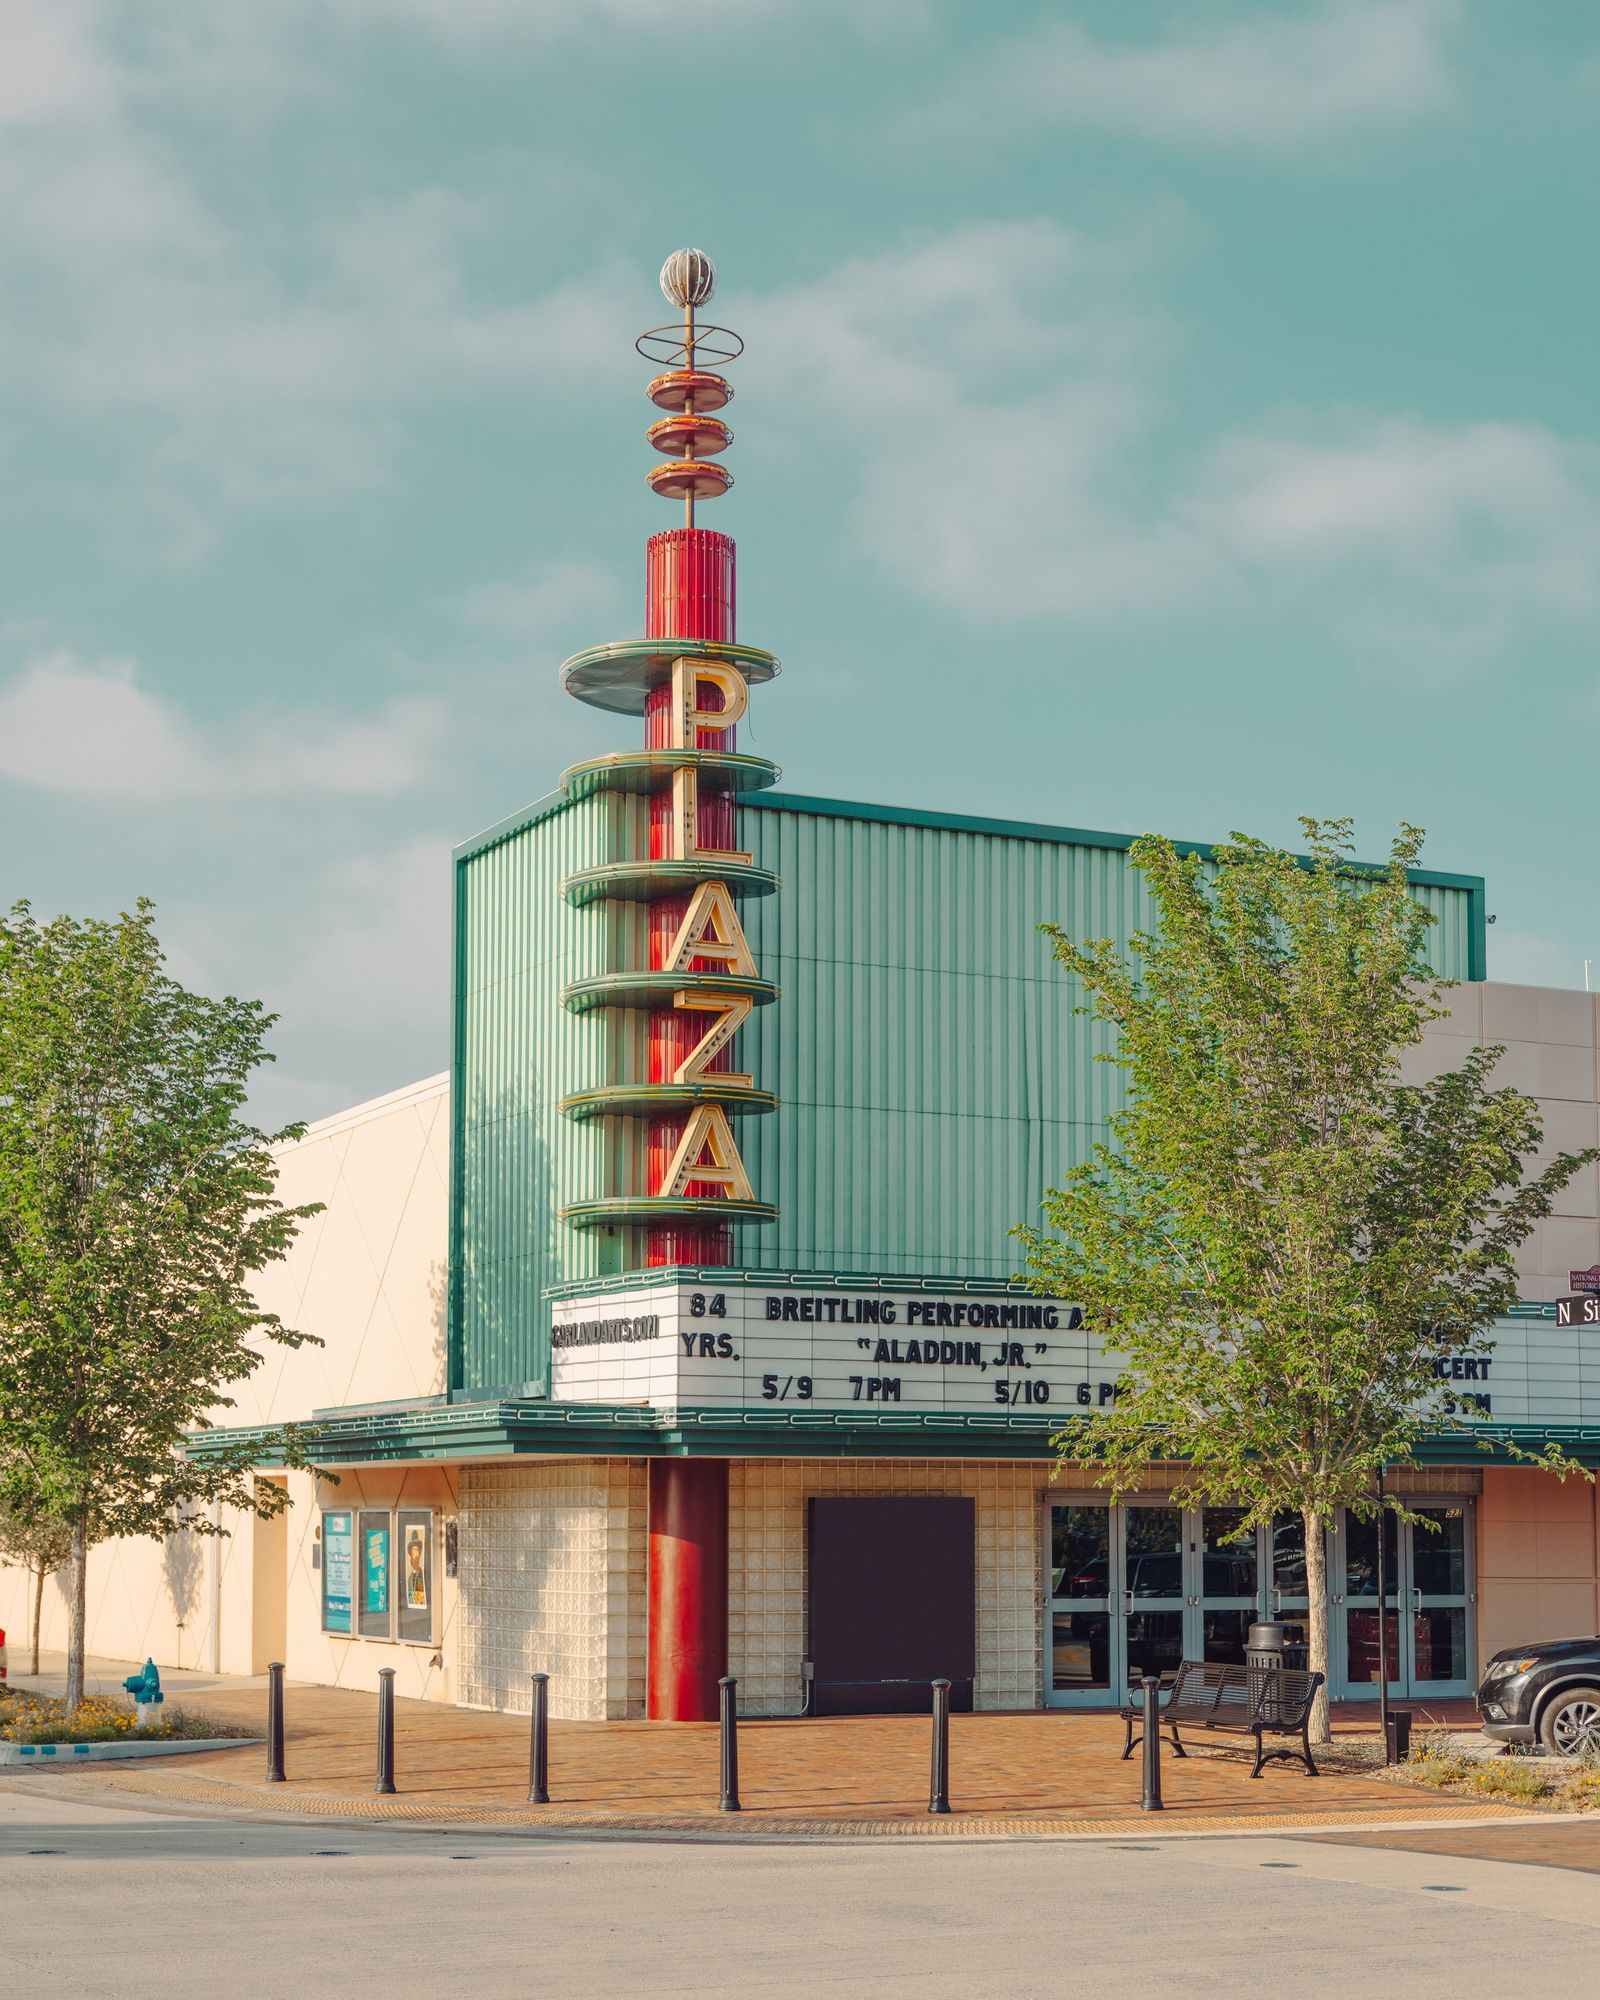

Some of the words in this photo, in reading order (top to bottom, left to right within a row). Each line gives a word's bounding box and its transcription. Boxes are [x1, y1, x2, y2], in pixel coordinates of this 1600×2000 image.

[660, 656, 758, 1201] PLAZA
[690, 1293, 727, 1318] 84
[765, 1296, 896, 1325] BREITLING
[907, 1301, 1059, 1329] PERFORMING
[1558, 1302, 1571, 1324] N
[1583, 1299, 1600, 1322] Si
[681, 1332, 740, 1361] YRS.
[857, 1337, 988, 1372] "ALADDIN,
[762, 1374, 813, 1401] 5/9
[994, 1380, 1050, 1406] 5/10
